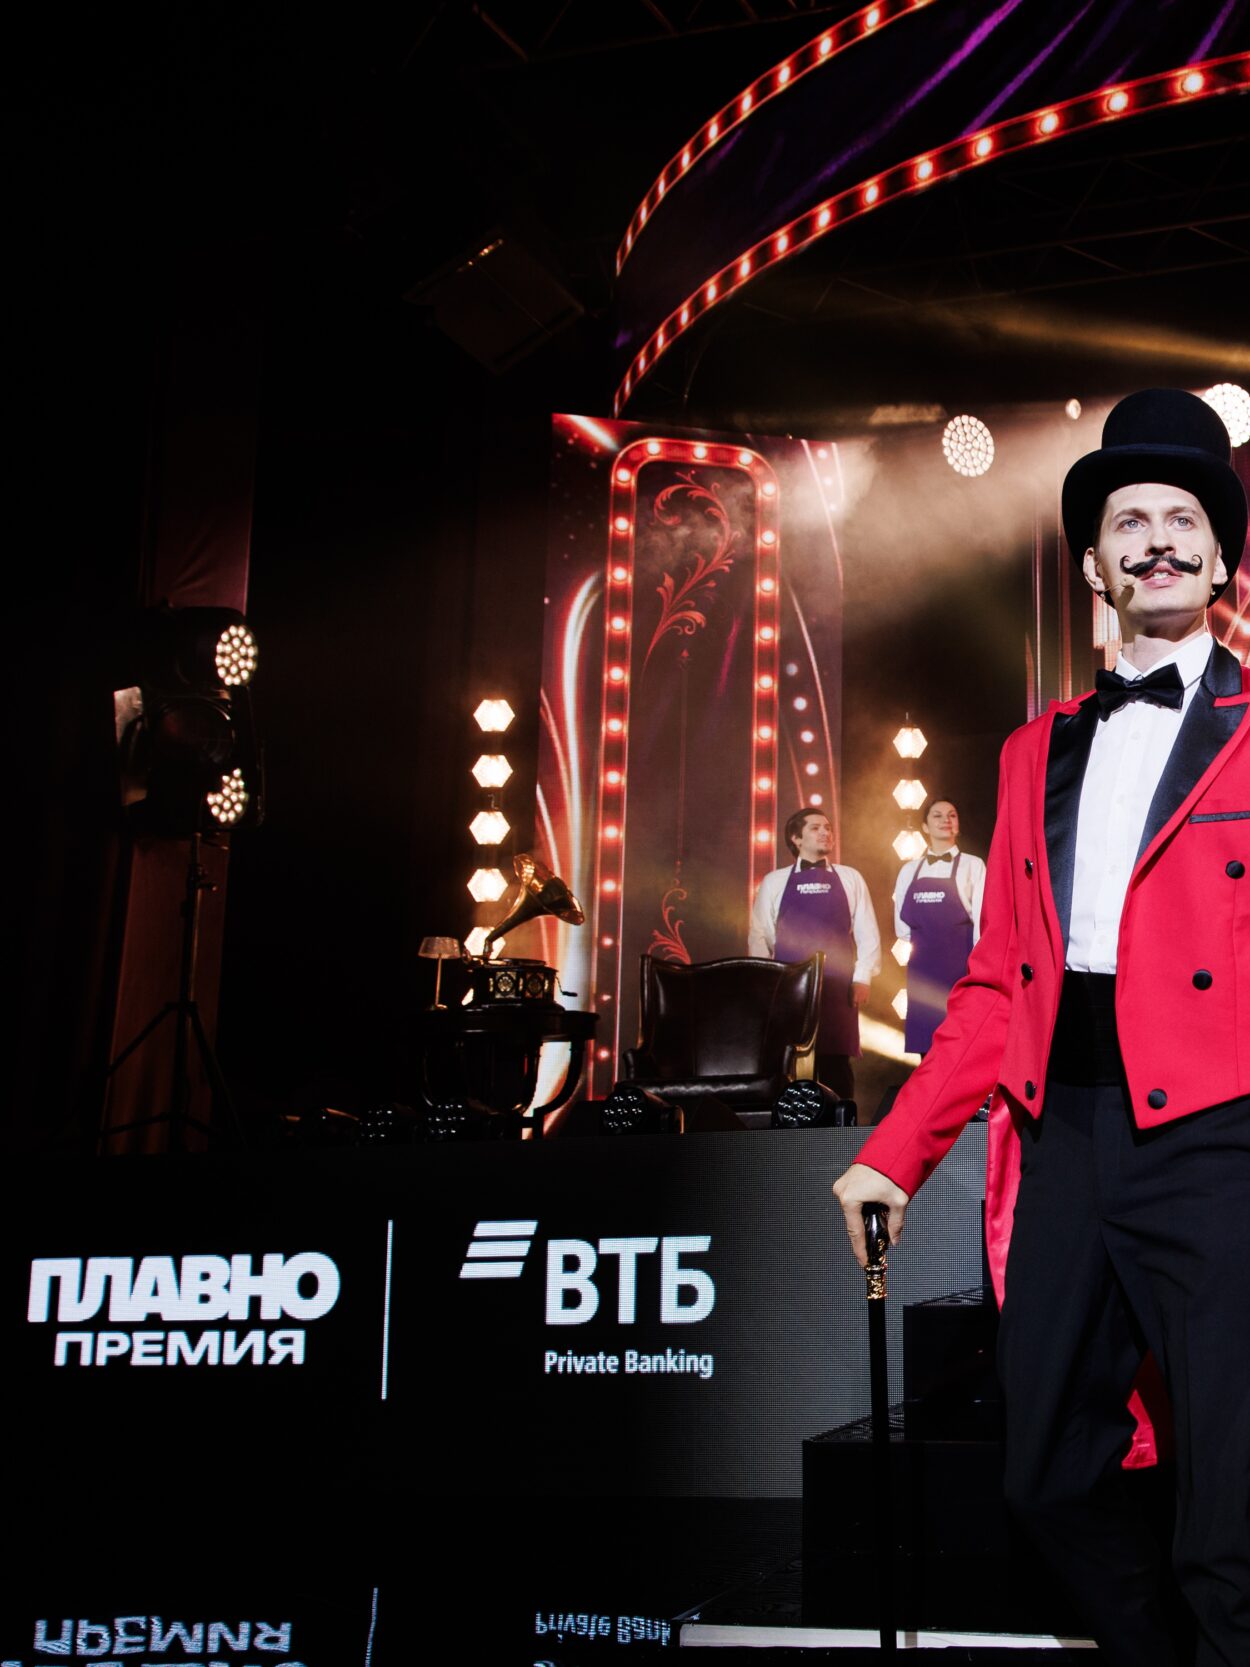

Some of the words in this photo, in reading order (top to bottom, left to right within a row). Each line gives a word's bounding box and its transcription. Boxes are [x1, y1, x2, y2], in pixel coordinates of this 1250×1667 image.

[28, 1251, 341, 1322] ПЛАВНО
[545, 1235, 716, 1325] ВТБ
[54, 1330, 305, 1366] ПРЕМИЯ
[544, 1349, 619, 1374] Private
[625, 1347, 713, 1378] Banking
